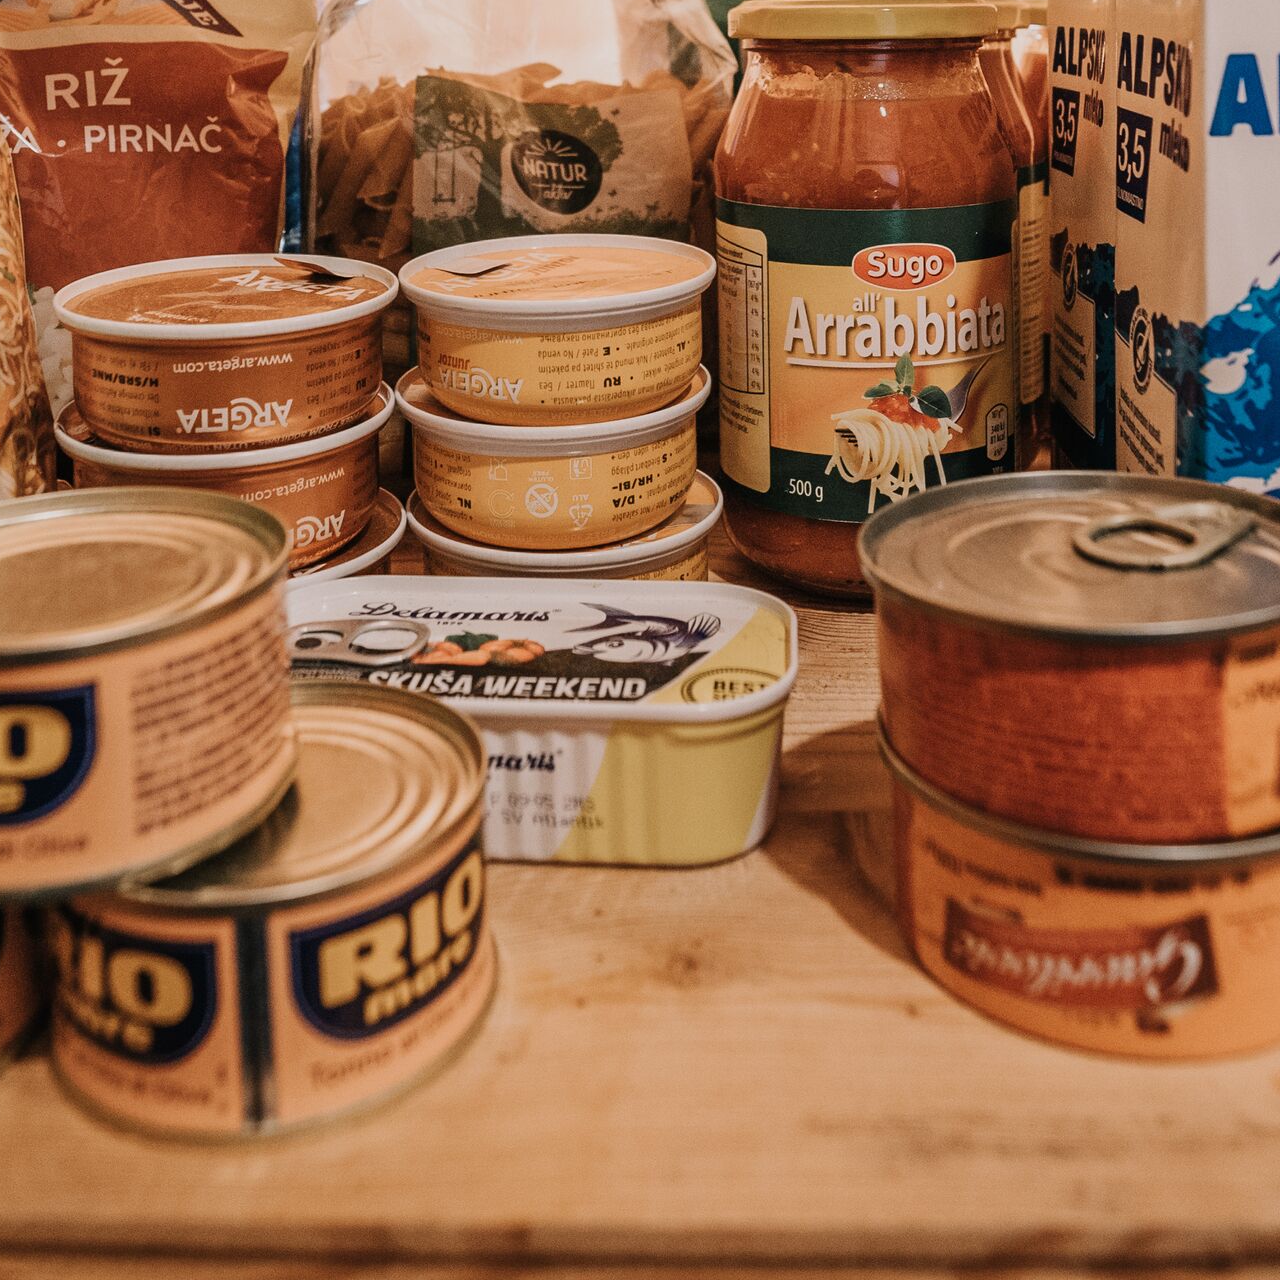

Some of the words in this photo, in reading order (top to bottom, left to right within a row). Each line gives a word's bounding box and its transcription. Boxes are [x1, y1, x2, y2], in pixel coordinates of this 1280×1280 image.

[1053, 26, 1106, 84] ALPSKO
[44, 56, 132, 111] RIŽ
[1117, 32, 1192, 117] ALPSKO
[83, 115, 223, 154] PIRNAČ
[1056, 98, 1076, 147] 3,5
[523, 156, 588, 182] NATUR
[1118, 122, 1146, 184] 3,5
[867, 251, 943, 284] Sugo
[783, 293, 1006, 358] Arrabbiata
[172, 352, 293, 375] www.argeta.com
[603, 346, 610, 356] E
[676, 340, 686, 353] AL
[436, 367, 524, 404] ARGETA
[603, 375, 621, 387] RU
[175, 396, 294, 434] ARGETA
[662, 453, 668, 463] S
[240, 466, 346, 504] www.argeta.com
[457, 497, 471, 509] NL
[612, 495, 635, 508] D/A
[788, 478, 812, 497] 500
[815, 485, 824, 502] g
[285, 509, 346, 549] ARG
[348, 601, 551, 624] Delamaris
[368, 669, 473, 696] SKUŠA
[483, 675, 647, 699] WEEKEND
[318, 849, 484, 1010] RIO
[362, 930, 473, 1025] mare
